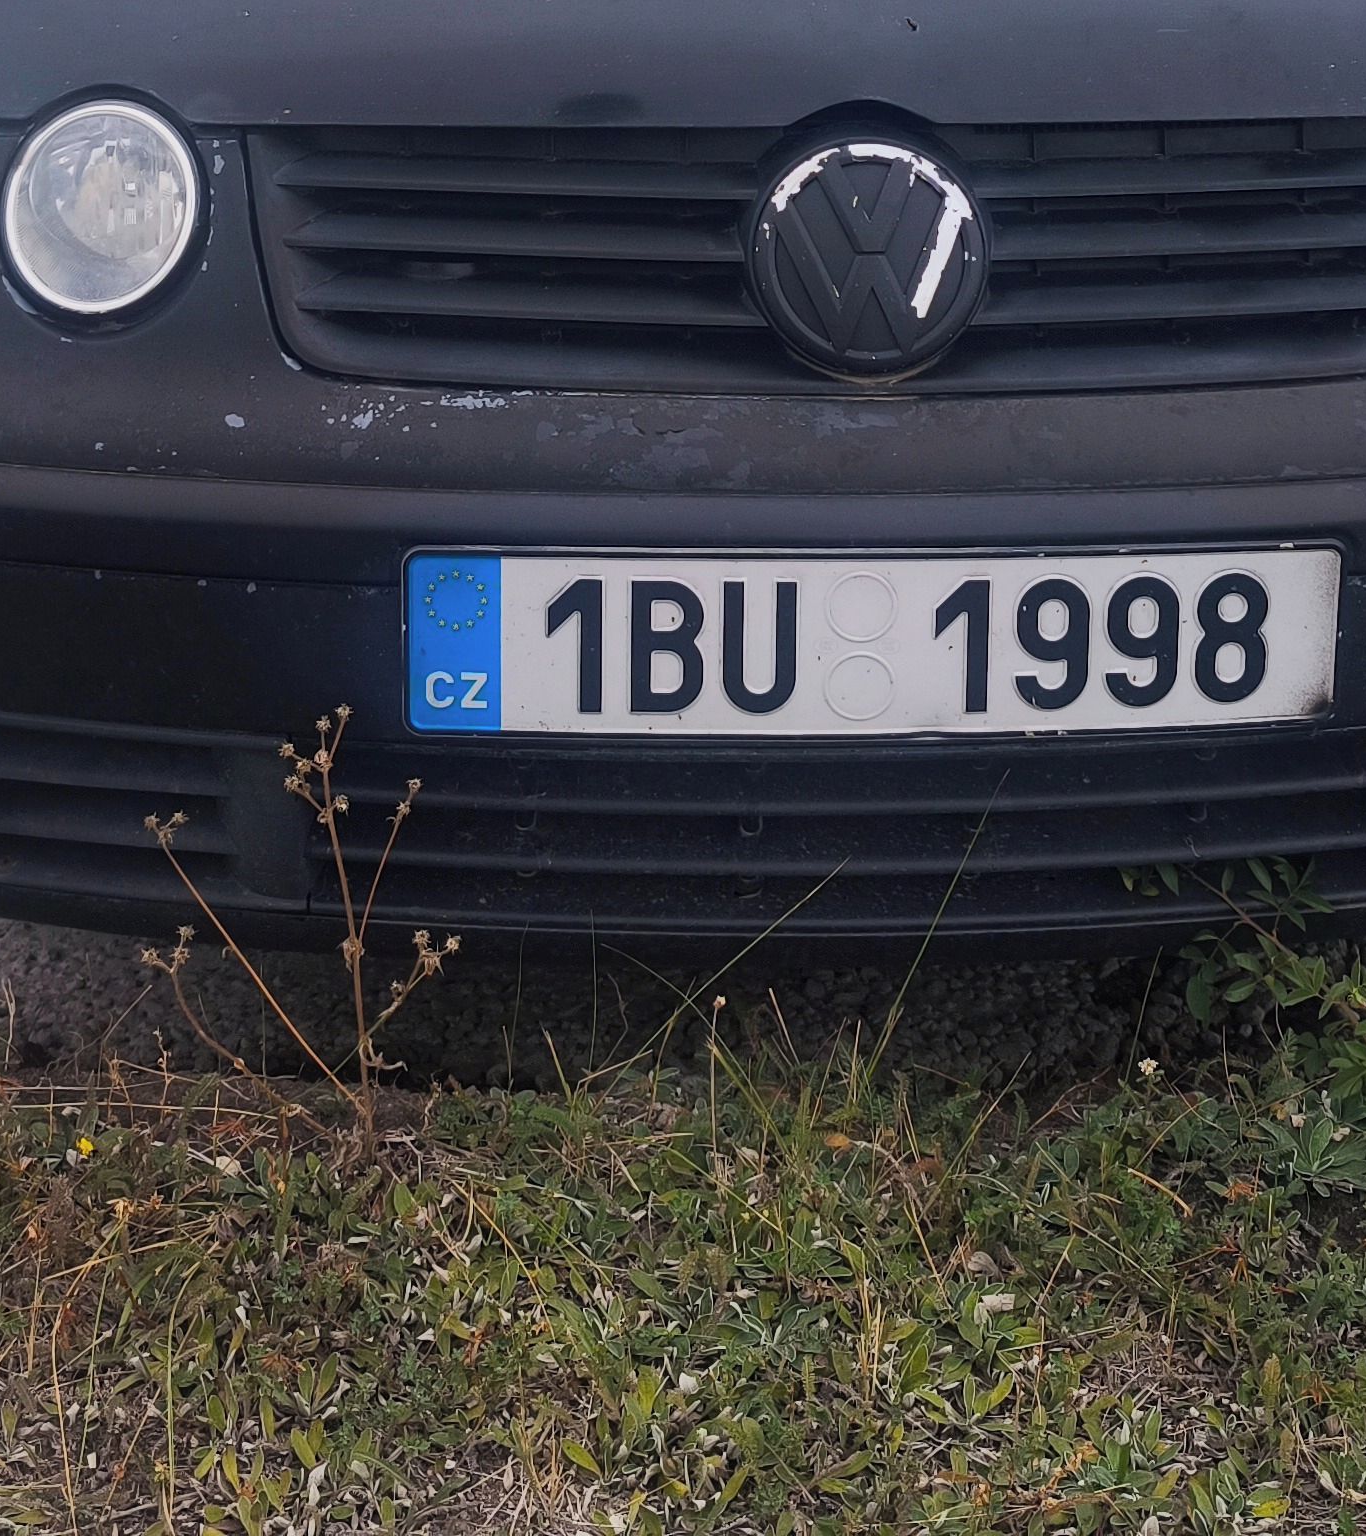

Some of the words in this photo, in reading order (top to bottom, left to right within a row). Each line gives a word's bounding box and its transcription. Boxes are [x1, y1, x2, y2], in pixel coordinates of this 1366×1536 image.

[426, 671, 488, 709] CZ
[544, 575, 798, 714] 1BU
[932, 572, 1270, 714] 1998
